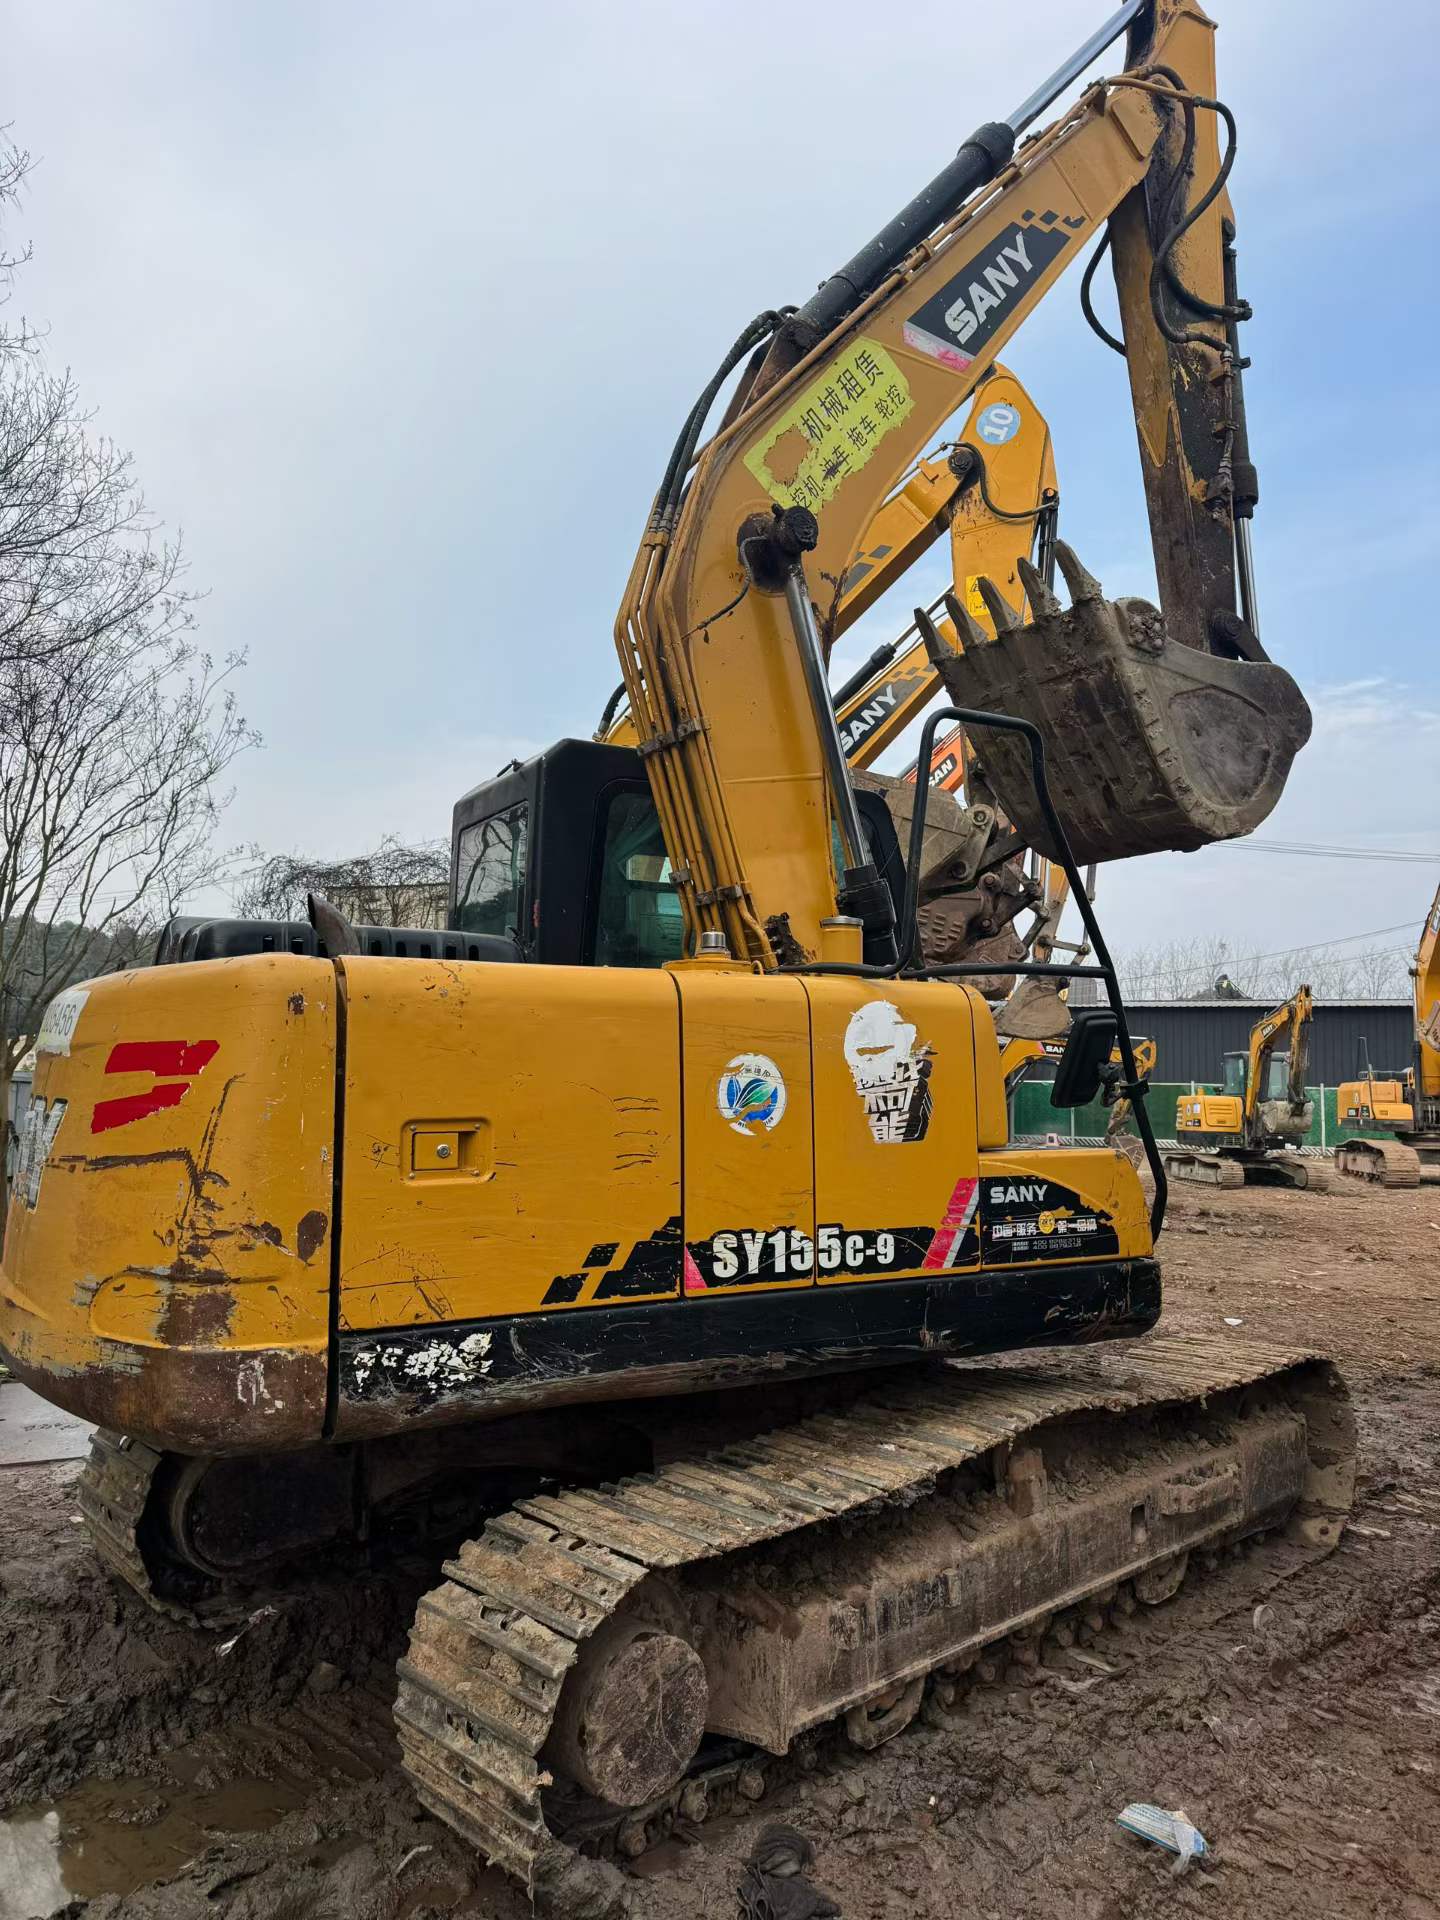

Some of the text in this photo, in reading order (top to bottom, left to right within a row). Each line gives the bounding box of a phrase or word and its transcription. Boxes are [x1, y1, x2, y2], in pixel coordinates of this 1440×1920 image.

[944, 231, 1034, 344] SANY
[801, 349, 885, 444] 机械租赁
[984, 408, 1013, 440] 10
[840, 684, 897, 753] SANY
[1045, 1045, 1066, 1054] SAN
[990, 1184, 1048, 1204] SANY
